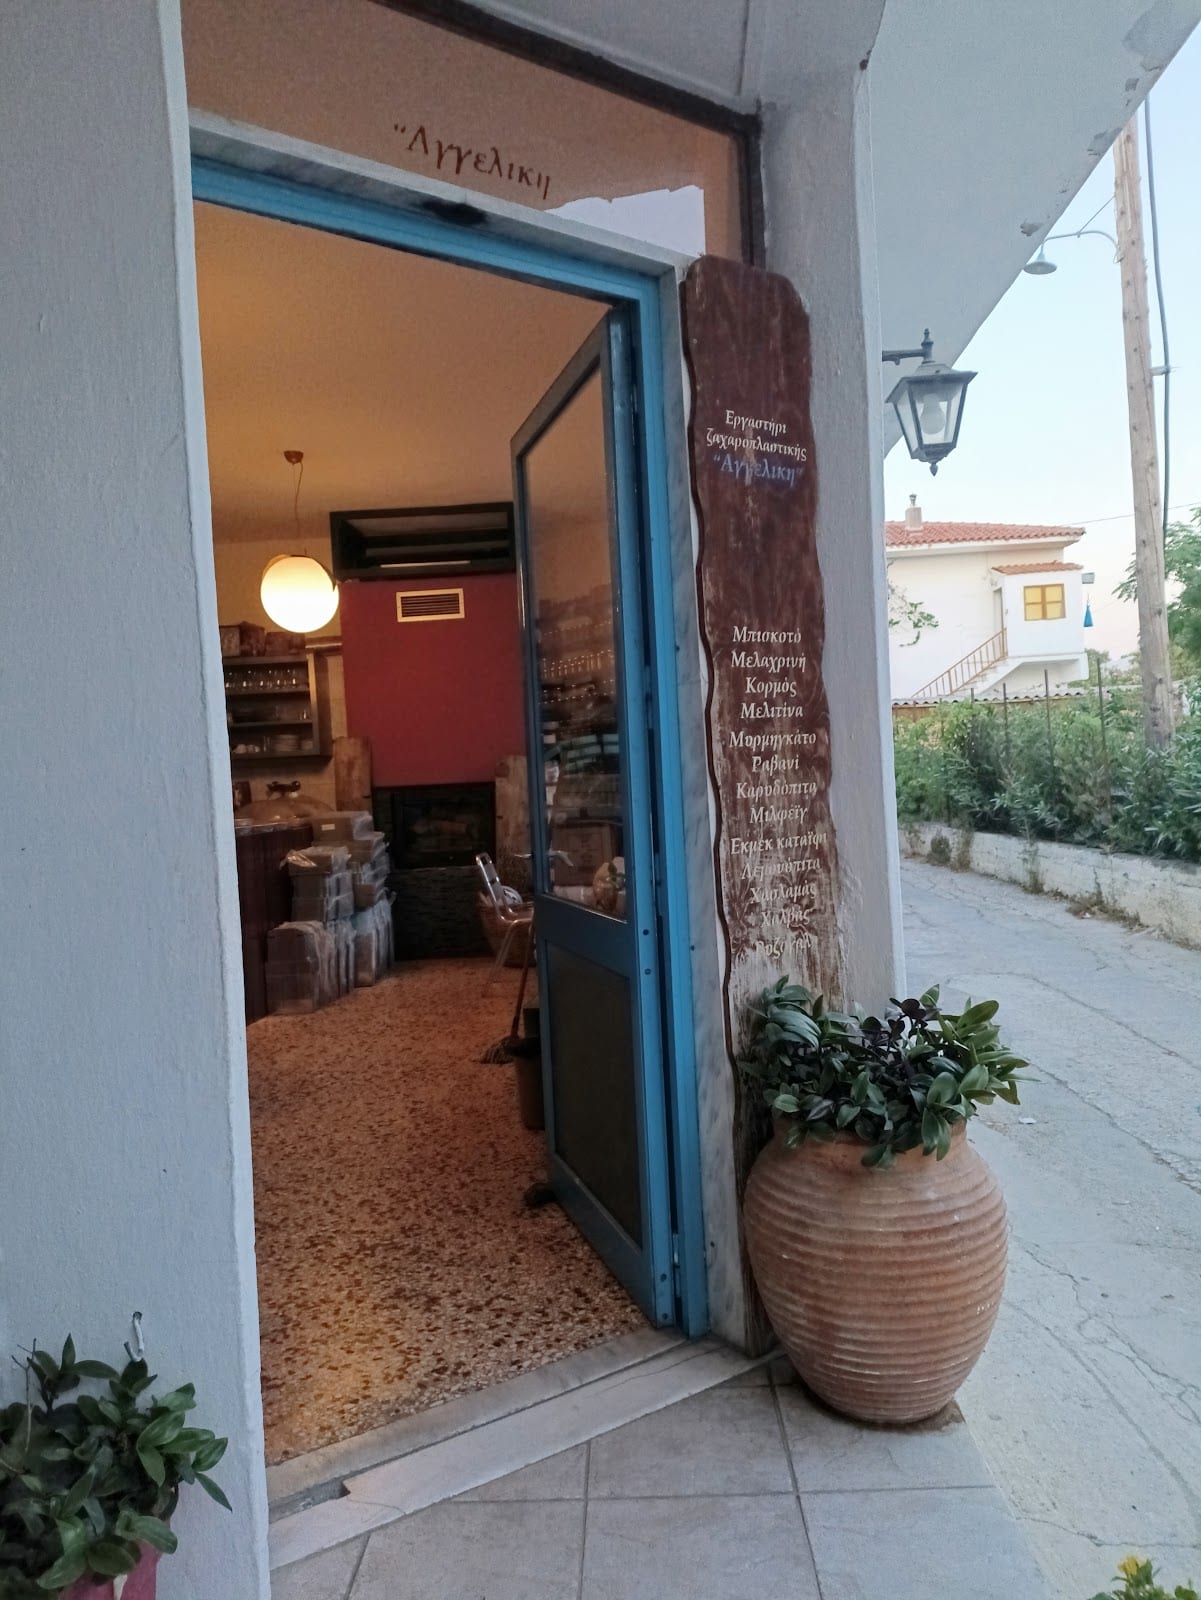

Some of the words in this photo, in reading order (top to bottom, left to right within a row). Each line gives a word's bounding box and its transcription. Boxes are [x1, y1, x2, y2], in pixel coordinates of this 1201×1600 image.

[725, 409, 787, 437] Εργαστήρι
[706, 427, 807, 462] ζαχαροπλαστικής
[731, 650, 806, 673] Μελαχρινή
[745, 676, 797, 697] Κορμός
[740, 702, 804, 719] Μελιτίνα
[729, 729, 817, 752] Μυρμηγκάτο
[751, 755, 800, 776] Ραβανί
